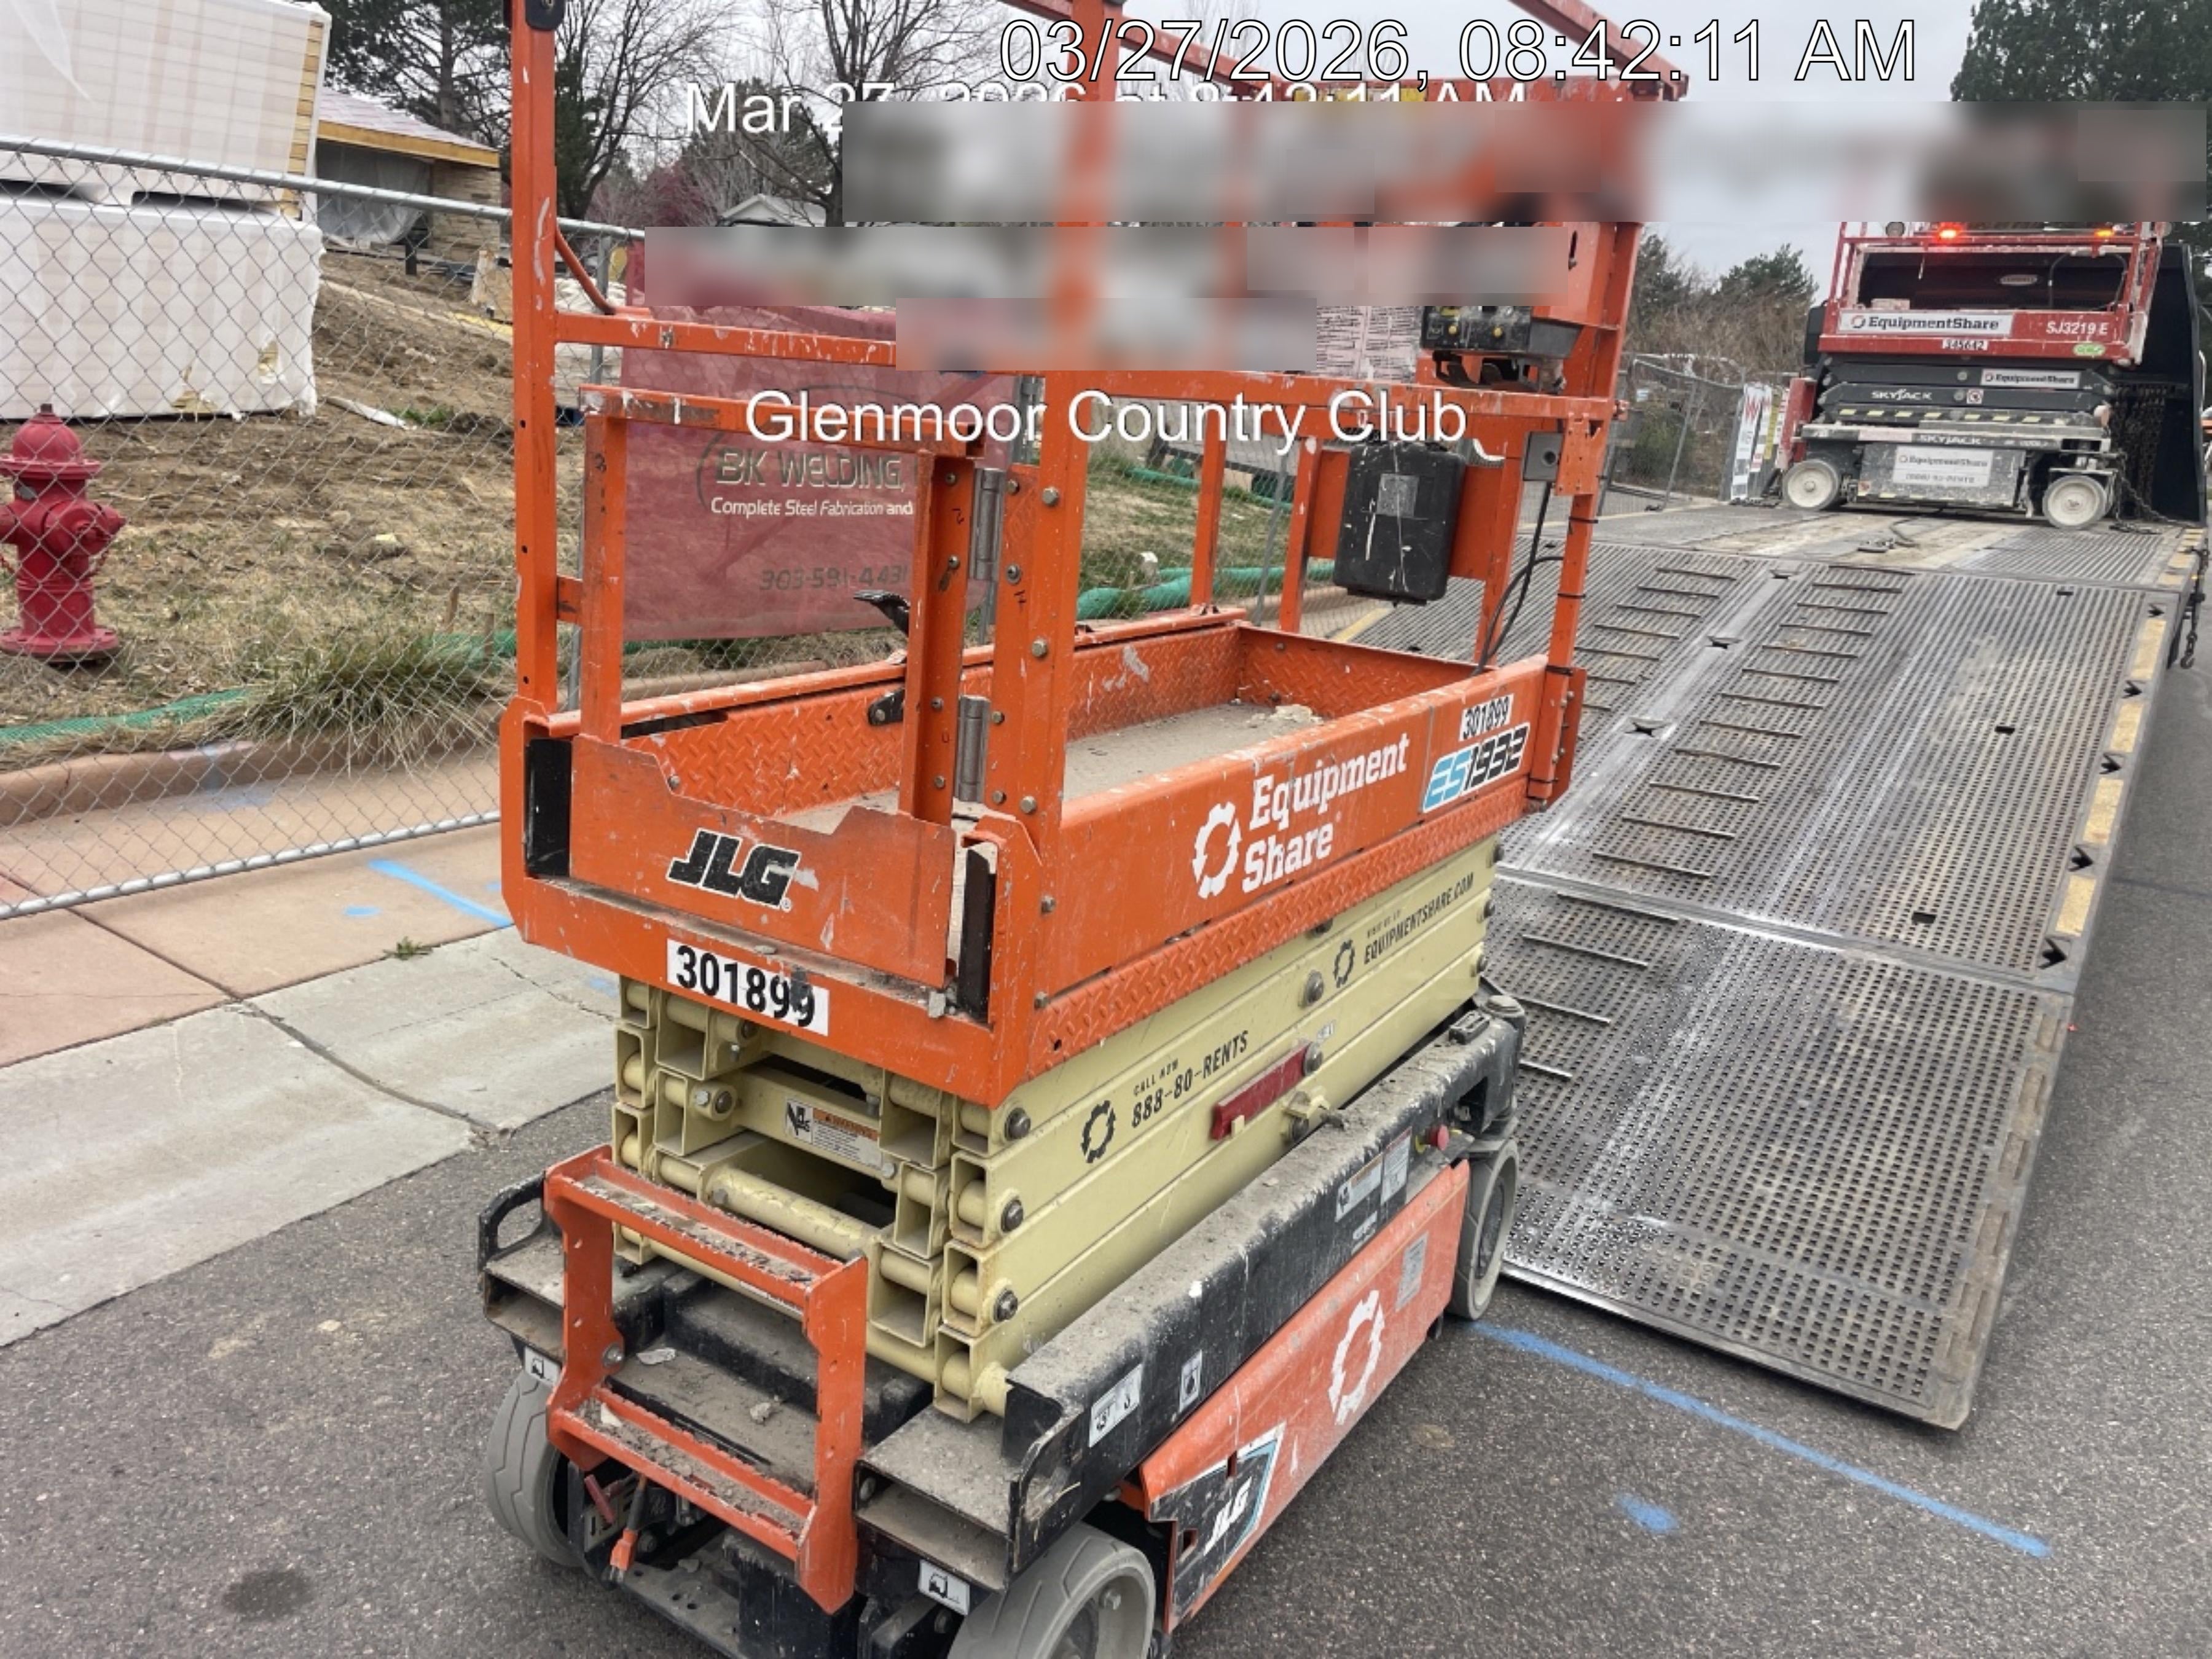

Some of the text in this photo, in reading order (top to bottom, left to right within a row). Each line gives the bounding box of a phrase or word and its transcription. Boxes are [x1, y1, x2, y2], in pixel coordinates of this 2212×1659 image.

[1869, 316, 1999, 331] EquipmentShare
[711, 496, 914, 519] Complete Steel Fabrication and
[1249, 732, 1410, 831] Equipment
[667, 828, 801, 908] JLG
[1242, 822, 1334, 893] Share
[1131, 1030, 1249, 1128] 888-80-RENTS
